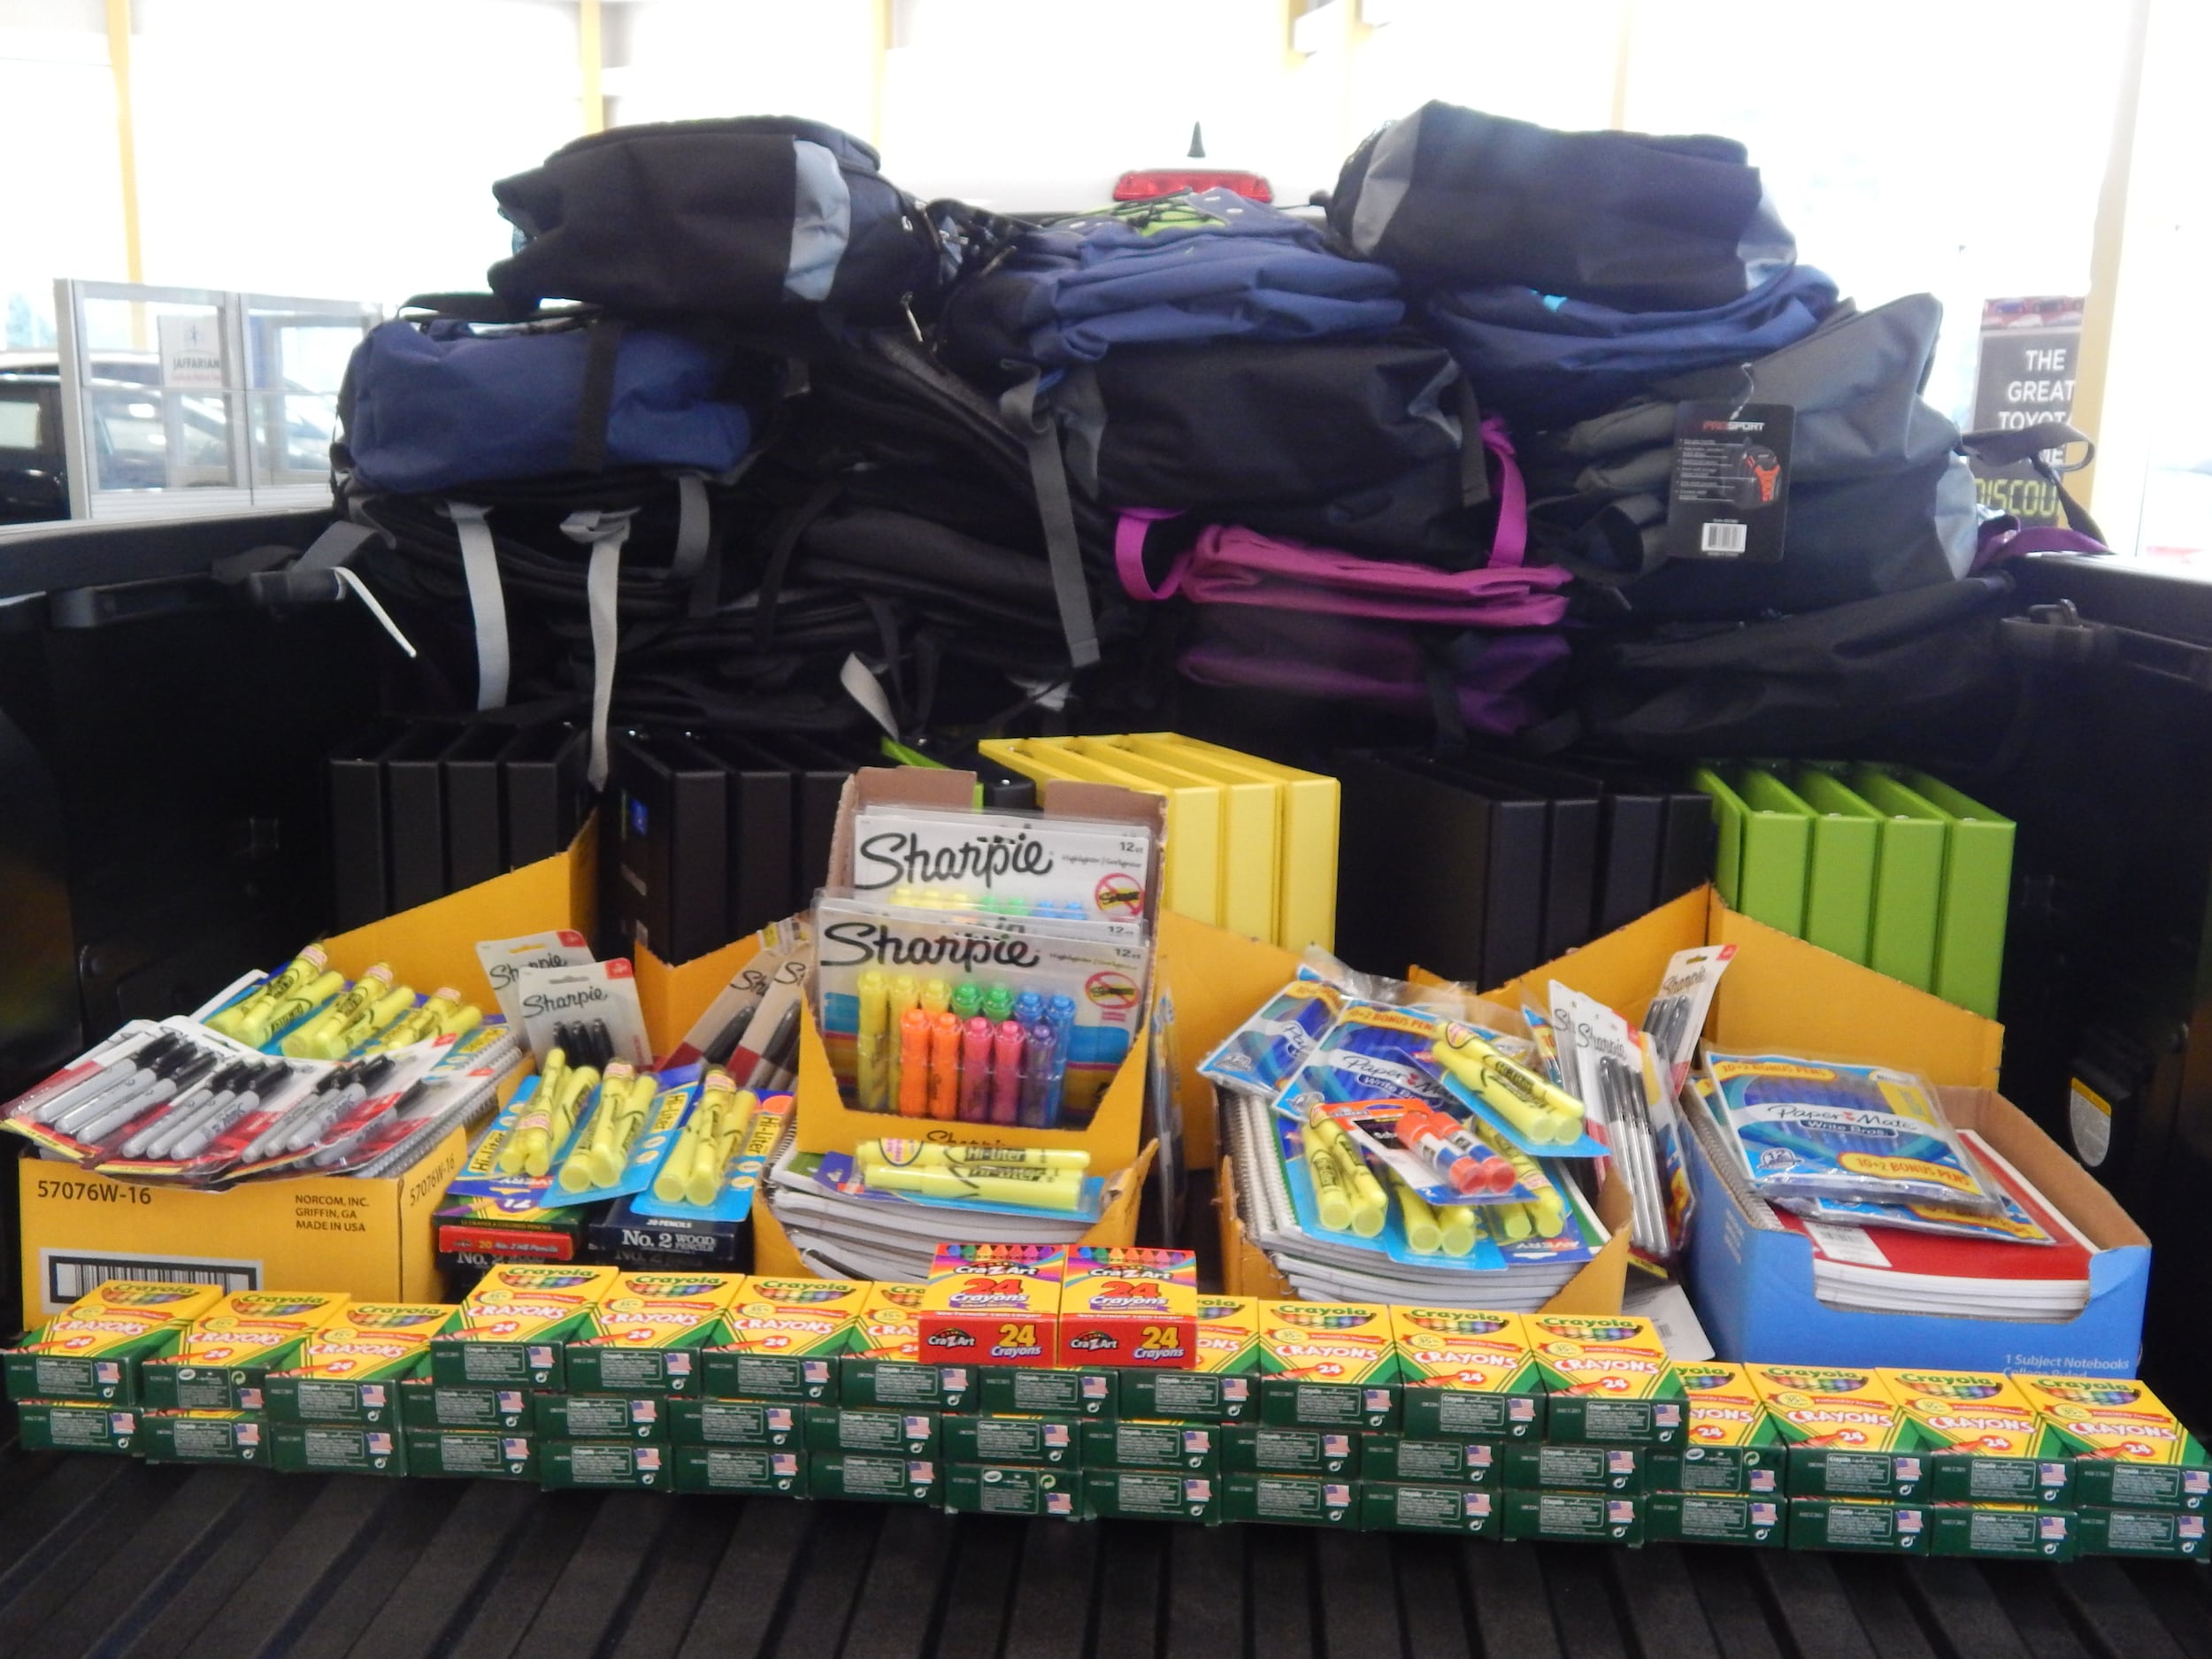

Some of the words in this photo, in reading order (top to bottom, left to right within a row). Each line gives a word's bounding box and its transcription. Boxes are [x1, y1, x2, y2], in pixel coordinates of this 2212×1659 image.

[2025, 349, 2067, 372] THE
[2008, 380, 2076, 403] GREAT
[1999, 411, 2072, 432] TOYOT
[1976, 479, 2058, 517] DISCOU
[855, 833, 1054, 889] Sharpie
[821, 922, 1040, 972] Sharpie
[490, 952, 567, 990] Shrpie
[522, 986, 608, 1018] Sharpie
[1411, 1020, 1434, 1030] PEN
[1343, 1056, 1407, 1079] Paper
[1768, 1104, 1844, 1121] Paper
[1857, 1113, 1916, 1131] Mate
[1808, 1120, 1848, 1130] Write
[749, 1115, 780, 1156] Hi-Liter
[410, 1153, 455, 1207] 57076W-16
[1890, 1160, 1935, 1176] BONUS
[1938, 1170, 1970, 1187] PENS
[38, 1180, 151, 1204] 57076W-16
[295, 1194, 346, 1207] NORCOM,
[349, 1197, 370, 1207] INC.
[296, 1208, 339, 1218] GRIFFIN,
[342, 1210, 357, 1219] GA
[296, 1220, 328, 1230] MADE
[331, 1222, 342, 1231] IN
[344, 1223, 366, 1232] USA
[621, 1229, 654, 1248] No.
[658, 1233, 673, 1248] 2
[675, 1233, 716, 1246] WOOD
[510, 1267, 594, 1277] Crayola
[635, 1276, 720, 1285] Crayola
[763, 1280, 849, 1292] Crayola
[962, 1278, 1024, 1295] 24
[113, 1283, 194, 1294] Crayola
[1100, 1280, 1161, 1298] 24
[242, 1294, 324, 1305] Crayola
[949, 1293, 1030, 1304] Crayons
[1088, 1295, 1168, 1307] Crayons
[358, 1305, 442, 1316] Crayola
[466, 1305, 566, 1318] CRAYONS
[1279, 1305, 1368, 1316] Crayola
[1411, 1309, 1501, 1322] Crayola
[601, 1314, 700, 1325] CRAYONS
[733, 1319, 833, 1333] CRAYONS
[1544, 1317, 1637, 1328] Crayola
[52, 1320, 148, 1335] CRAYONS
[491, 1324, 516, 1333] 24
[868, 1325, 918, 1338] CRAY
[187, 1333, 284, 1346] CRAYONS
[628, 1330, 652, 1340] 24
[999, 1324, 1037, 1348] 24
[1141, 1326, 1180, 1350] 24
[764, 1337, 788, 1347] 24
[309, 1343, 405, 1357] CRAYONS
[990, 1344, 1041, 1357] Crayons
[1133, 1347, 1185, 1360] Crayons
[1275, 1345, 1379, 1361] CRAYONS
[1415, 1351, 1518, 1369] CRAYONS
[1555, 1359, 1659, 1374] CRAYONS
[2005, 1354, 2011, 1364] 1
[2014, 1354, 2062, 1369] Subject
[2064, 1357, 2130, 1370] Notebooks
[1318, 1363, 1341, 1374] 24
[1676, 1367, 1724, 1376] yola
[1768, 1367, 1858, 1379] Crayola
[1460, 1372, 1484, 1382] 24
[1901, 1373, 1993, 1386] Crayola
[1602, 1379, 1628, 1390] 24
[2038, 1378, 2134, 1392] Crayola
[1787, 1410, 1894, 1428] CRAYONS
[1928, 1417, 2035, 1434] CRAYONS
[1698, 1426, 1723, 1437] 24
[1839, 1431, 1864, 1441] 24
[2068, 1422, 2178, 1440] CRAYONS
[1984, 1436, 2009, 1448] 24
[2125, 1442, 2149, 1455] 24
